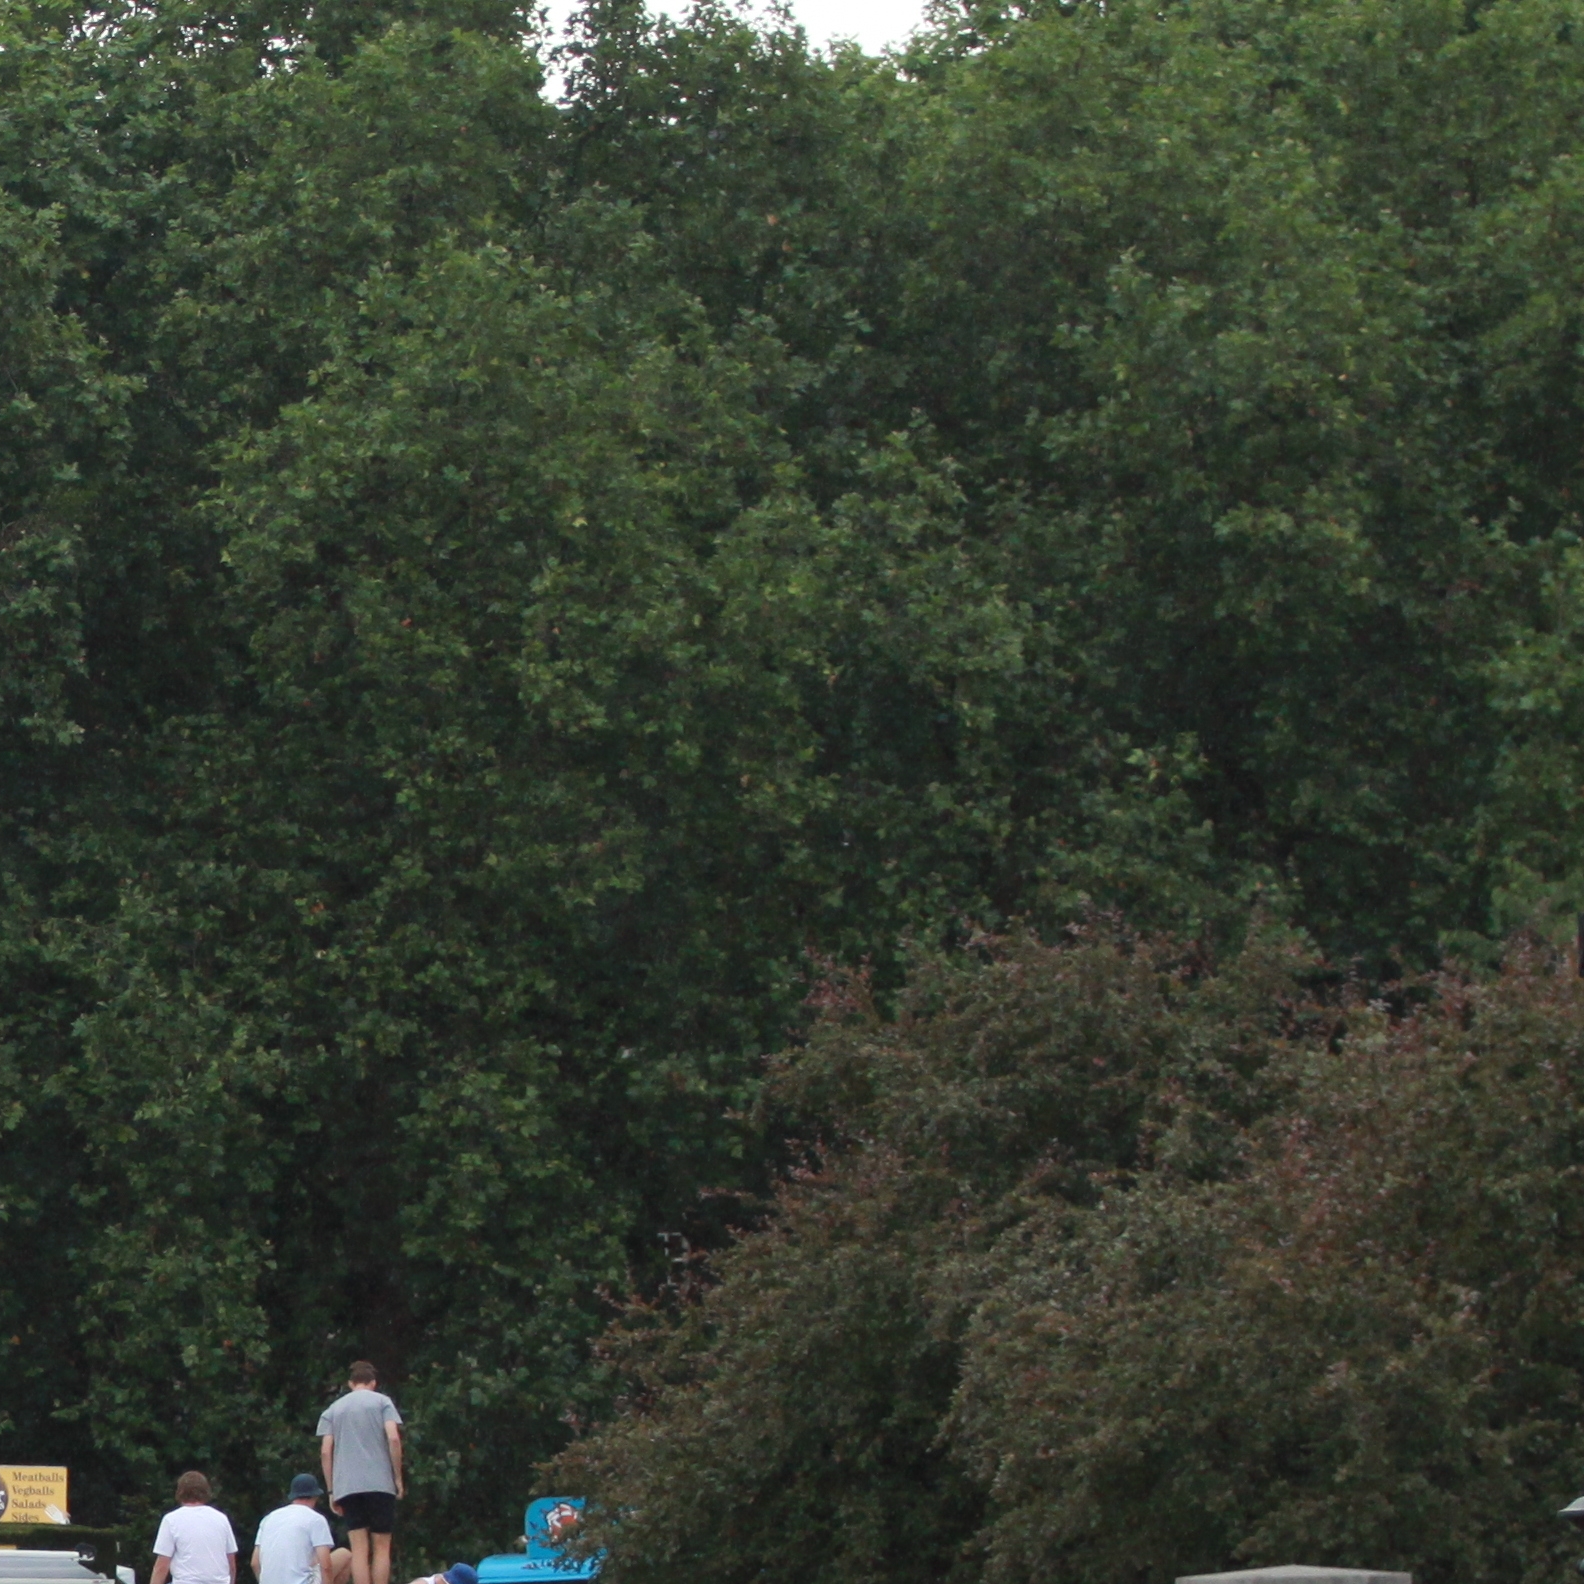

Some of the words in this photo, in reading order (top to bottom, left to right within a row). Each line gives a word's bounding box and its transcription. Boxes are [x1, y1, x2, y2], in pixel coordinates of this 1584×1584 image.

[12, 1471, 65, 1482] Meatballs
[12, 1486, 55, 1497] Vegballs
[12, 1499, 46, 1509] Salads
[12, 1512, 40, 1523] Sides
